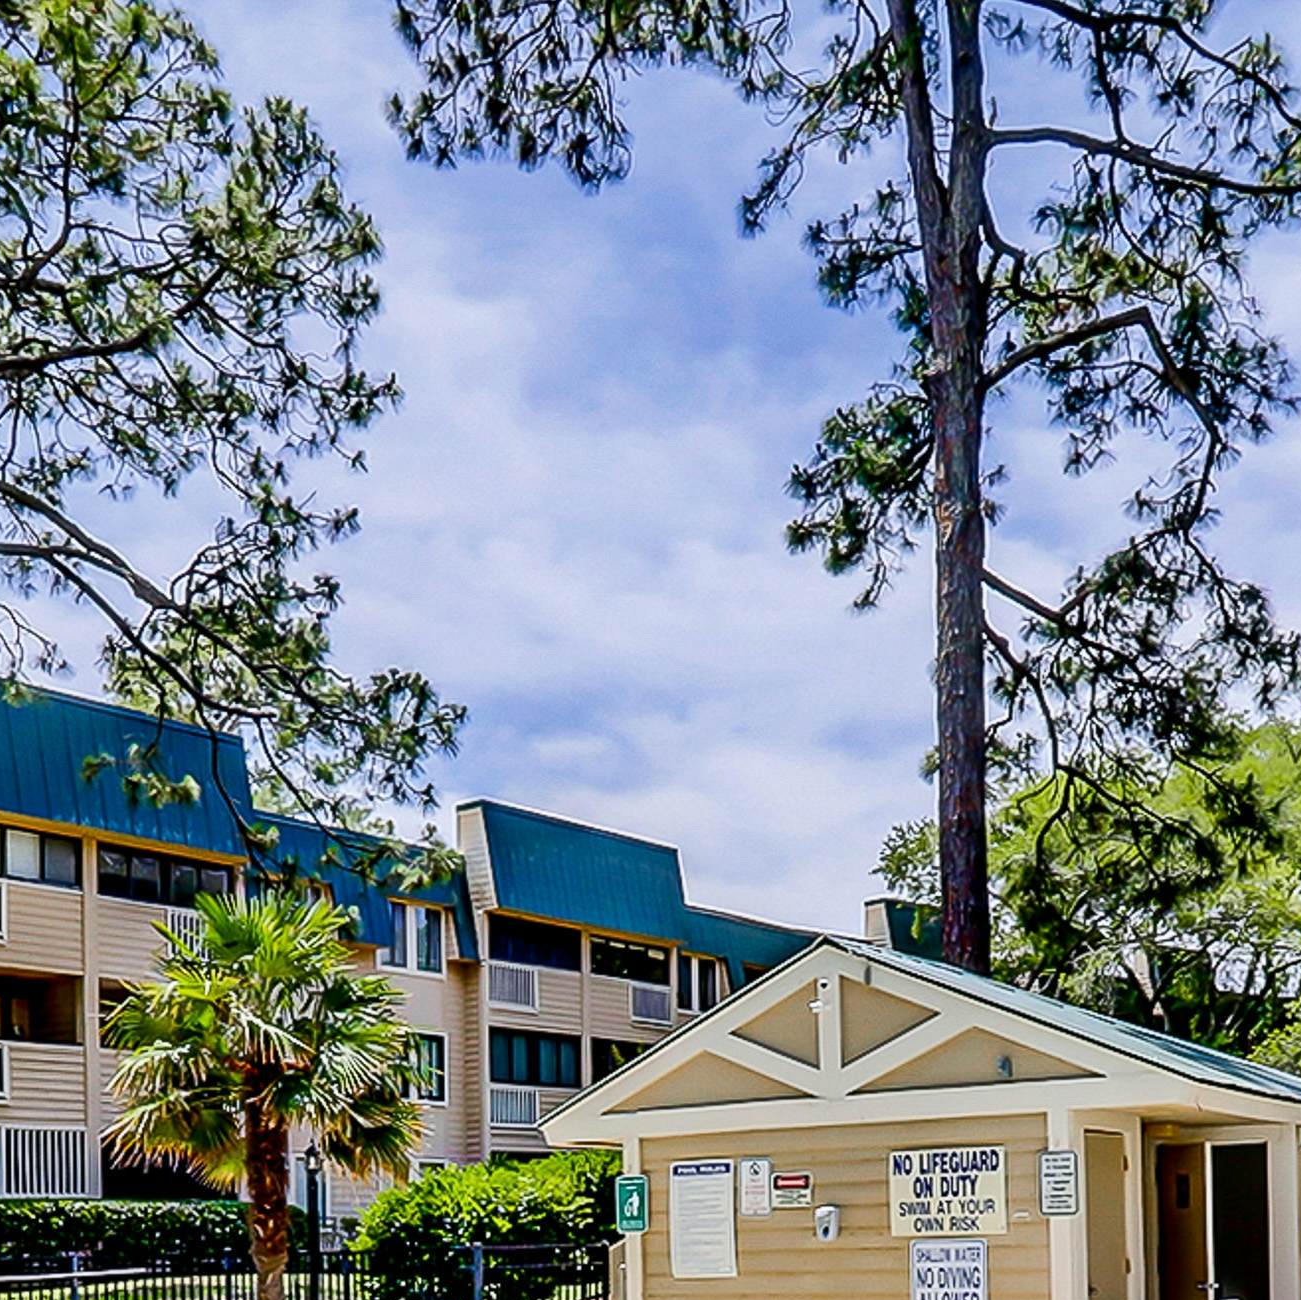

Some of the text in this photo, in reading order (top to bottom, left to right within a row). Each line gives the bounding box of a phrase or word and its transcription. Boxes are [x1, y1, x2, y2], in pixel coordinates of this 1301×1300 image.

[892, 1149, 1000, 1175] NO LIFEGUARD
[913, 1174, 979, 1198] ON DUTY
[899, 1198, 996, 1217] SWIM AT YOUR
[913, 1216, 980, 1233] OWN RISK
[917, 1266, 981, 1289] NO DIVING
